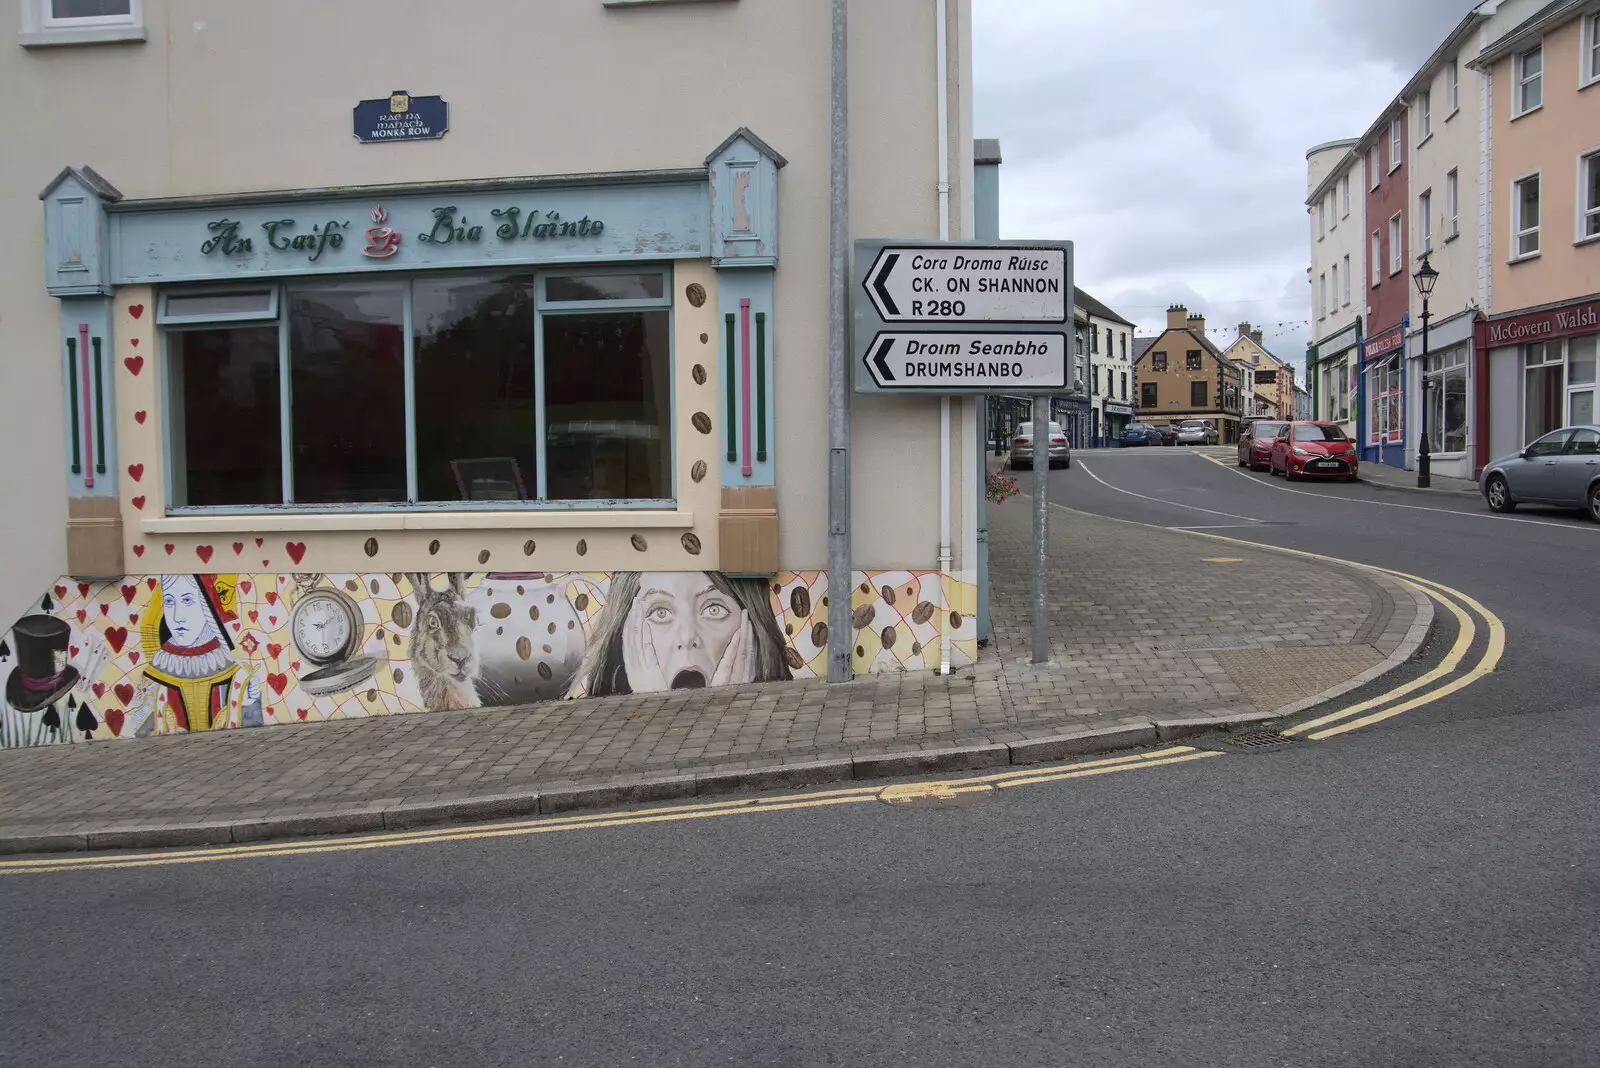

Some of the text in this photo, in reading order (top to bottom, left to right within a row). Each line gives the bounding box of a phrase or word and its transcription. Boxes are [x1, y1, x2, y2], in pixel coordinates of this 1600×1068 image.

[371, 127, 431, 138] MONKS ROW
[201, 218, 253, 255] An
[417, 205, 484, 245] Bia
[912, 255, 1049, 271] Cora Droma Rúisc
[912, 277, 1059, 293] CK. ON SHANNON
[1489, 306, 1597, 341] McGovern Walsh
[905, 340, 1048, 356] Droim Seanbhó
[905, 362, 1023, 377] DRUMSHANBO
